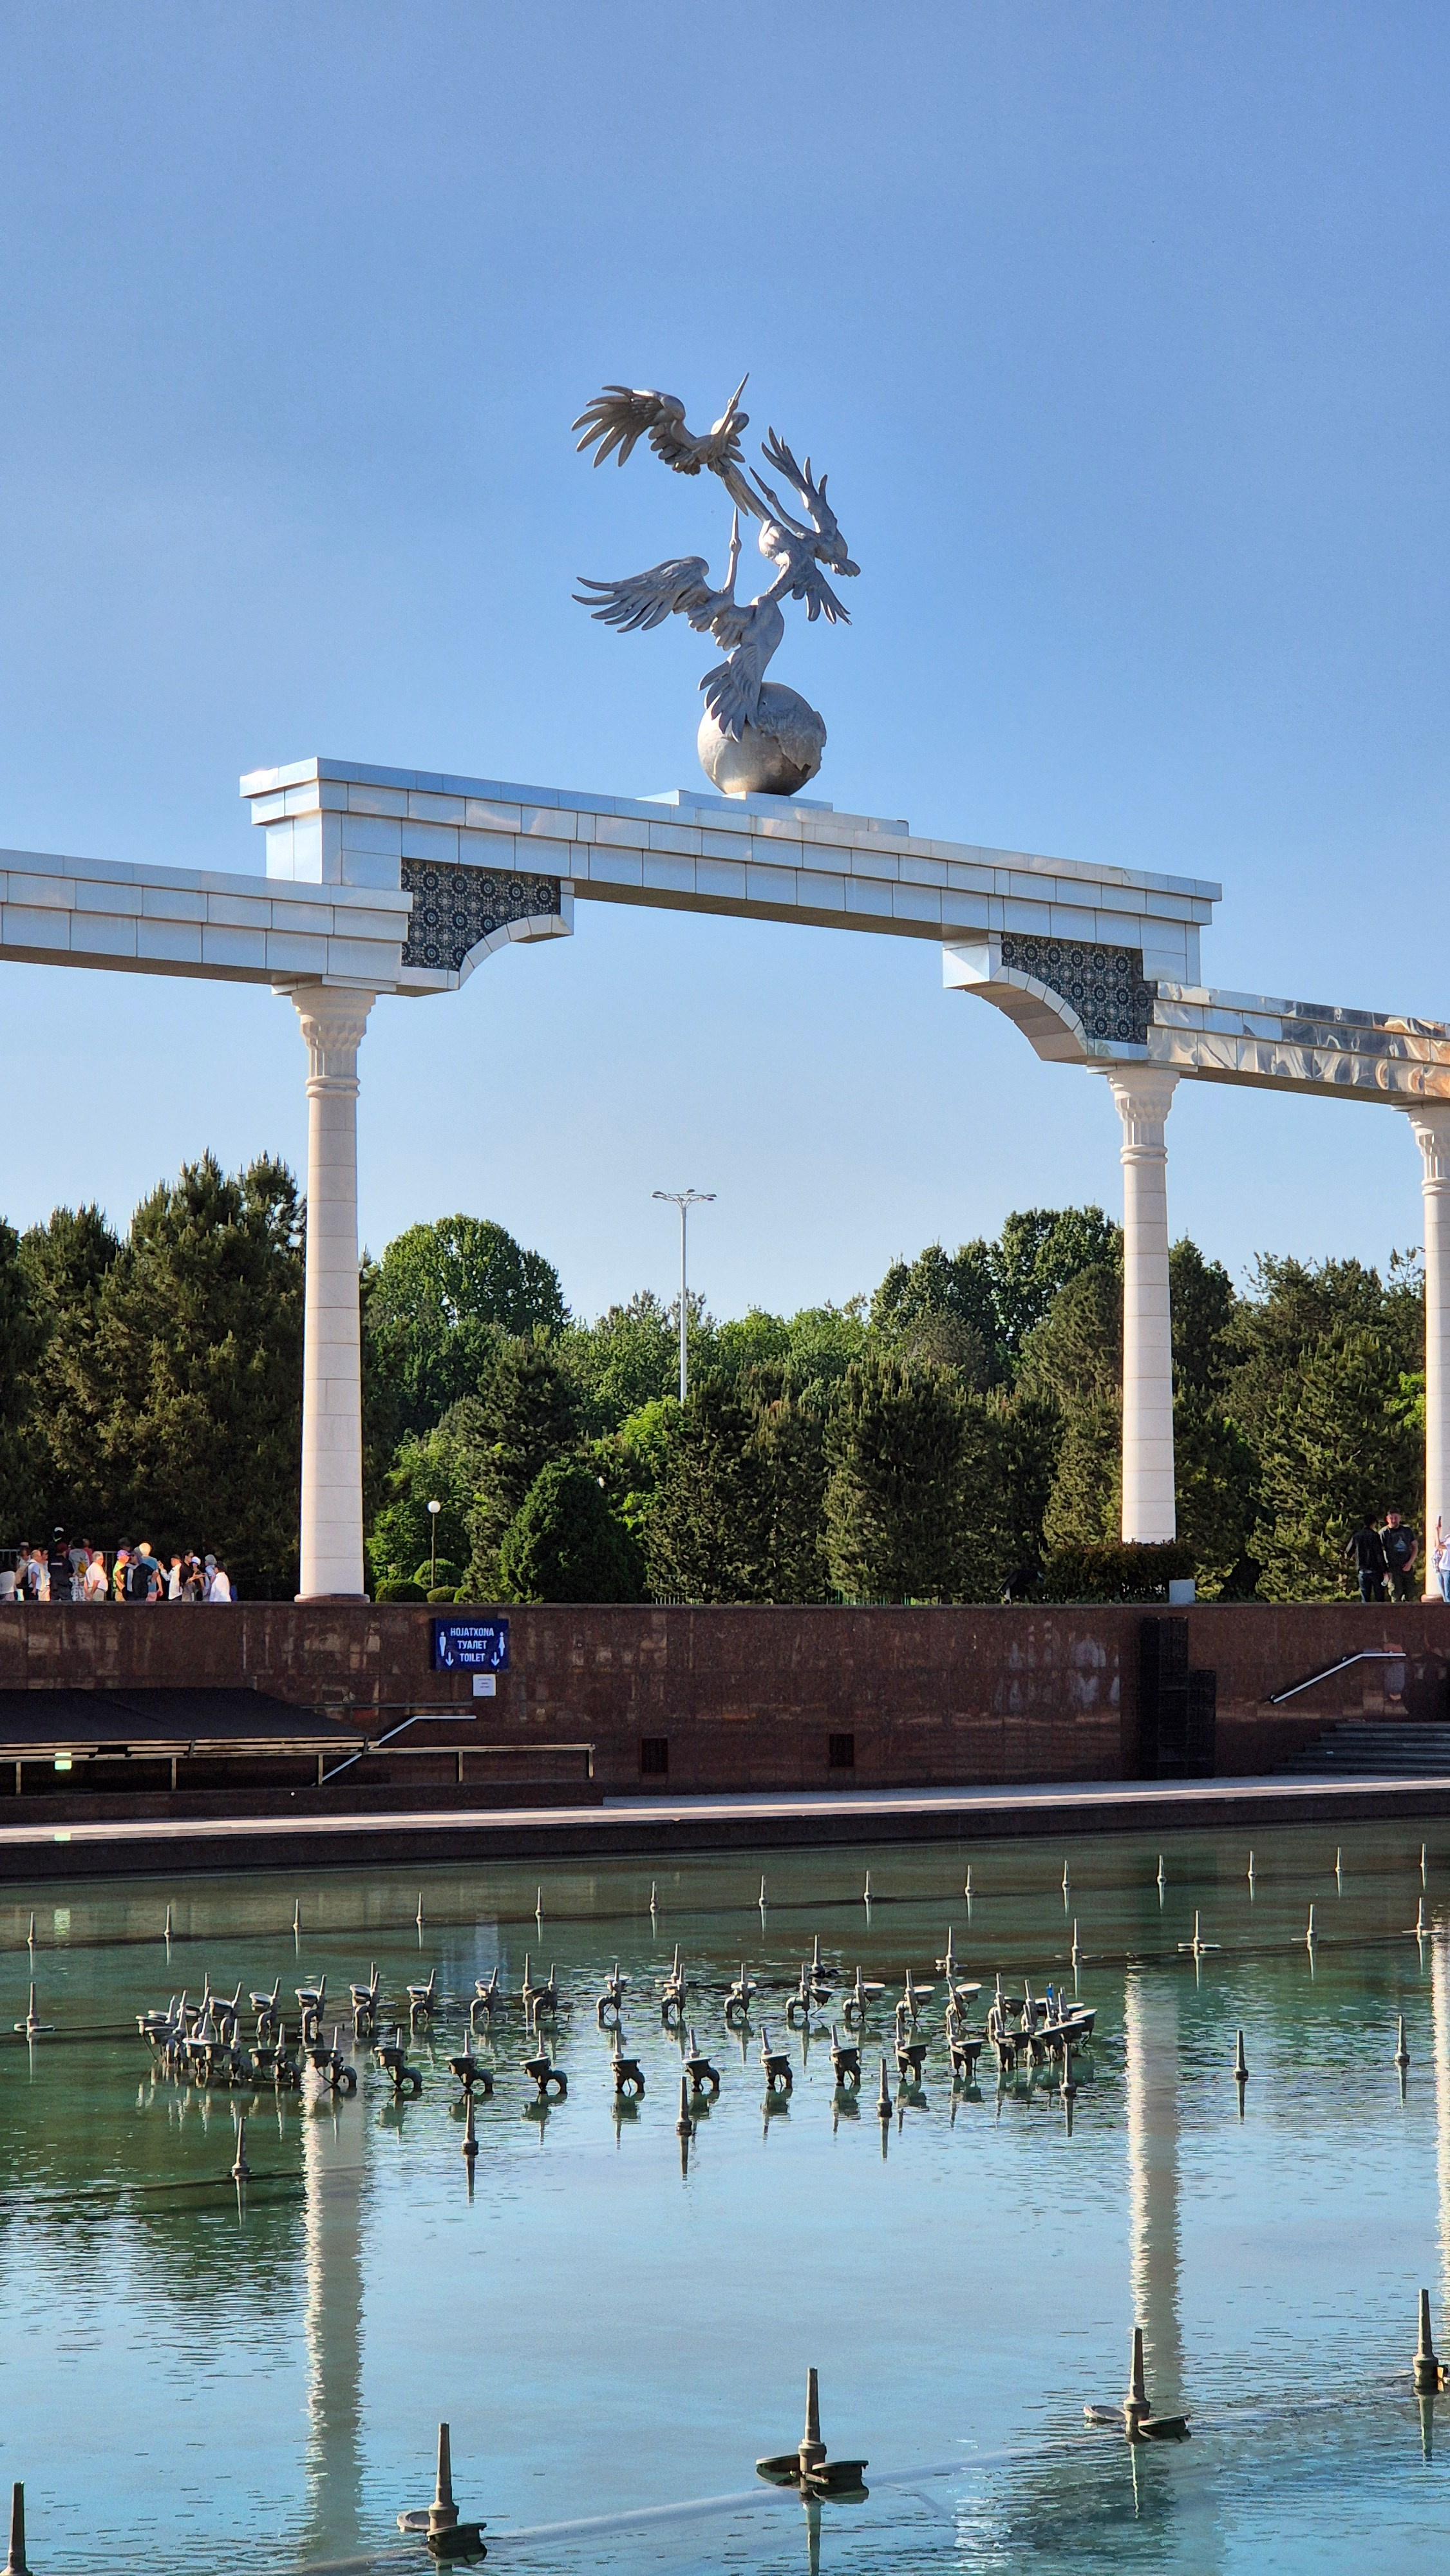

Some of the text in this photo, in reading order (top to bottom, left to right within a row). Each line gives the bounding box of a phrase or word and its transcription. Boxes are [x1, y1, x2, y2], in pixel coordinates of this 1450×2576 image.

[450, 1627, 494, 1636] HOJATXONA
[458, 1640, 487, 1649] ТУАЛЕТ
[459, 1653, 485, 1662] TOILET
